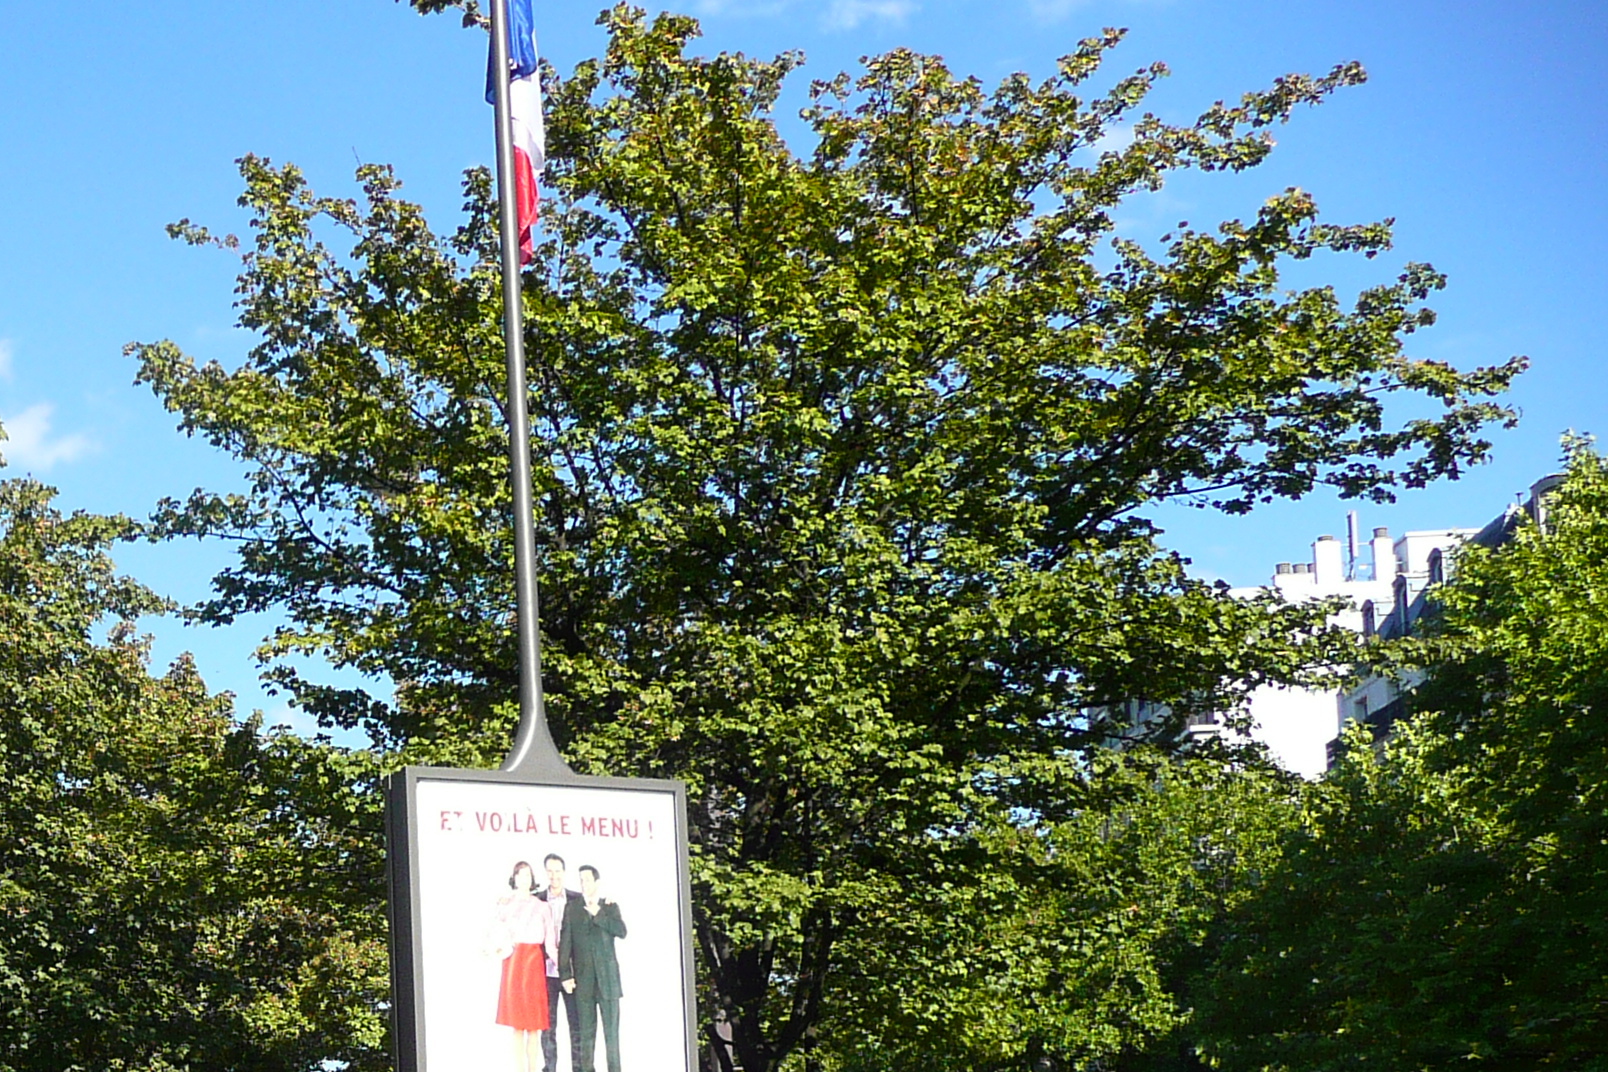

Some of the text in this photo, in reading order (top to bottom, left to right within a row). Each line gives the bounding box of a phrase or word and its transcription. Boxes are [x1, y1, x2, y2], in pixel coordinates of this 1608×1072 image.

[475, 806, 538, 833] VOILÀ
[547, 815, 572, 835] LE
[581, 817, 639, 839] MENU
[648, 820, 654, 840] !
